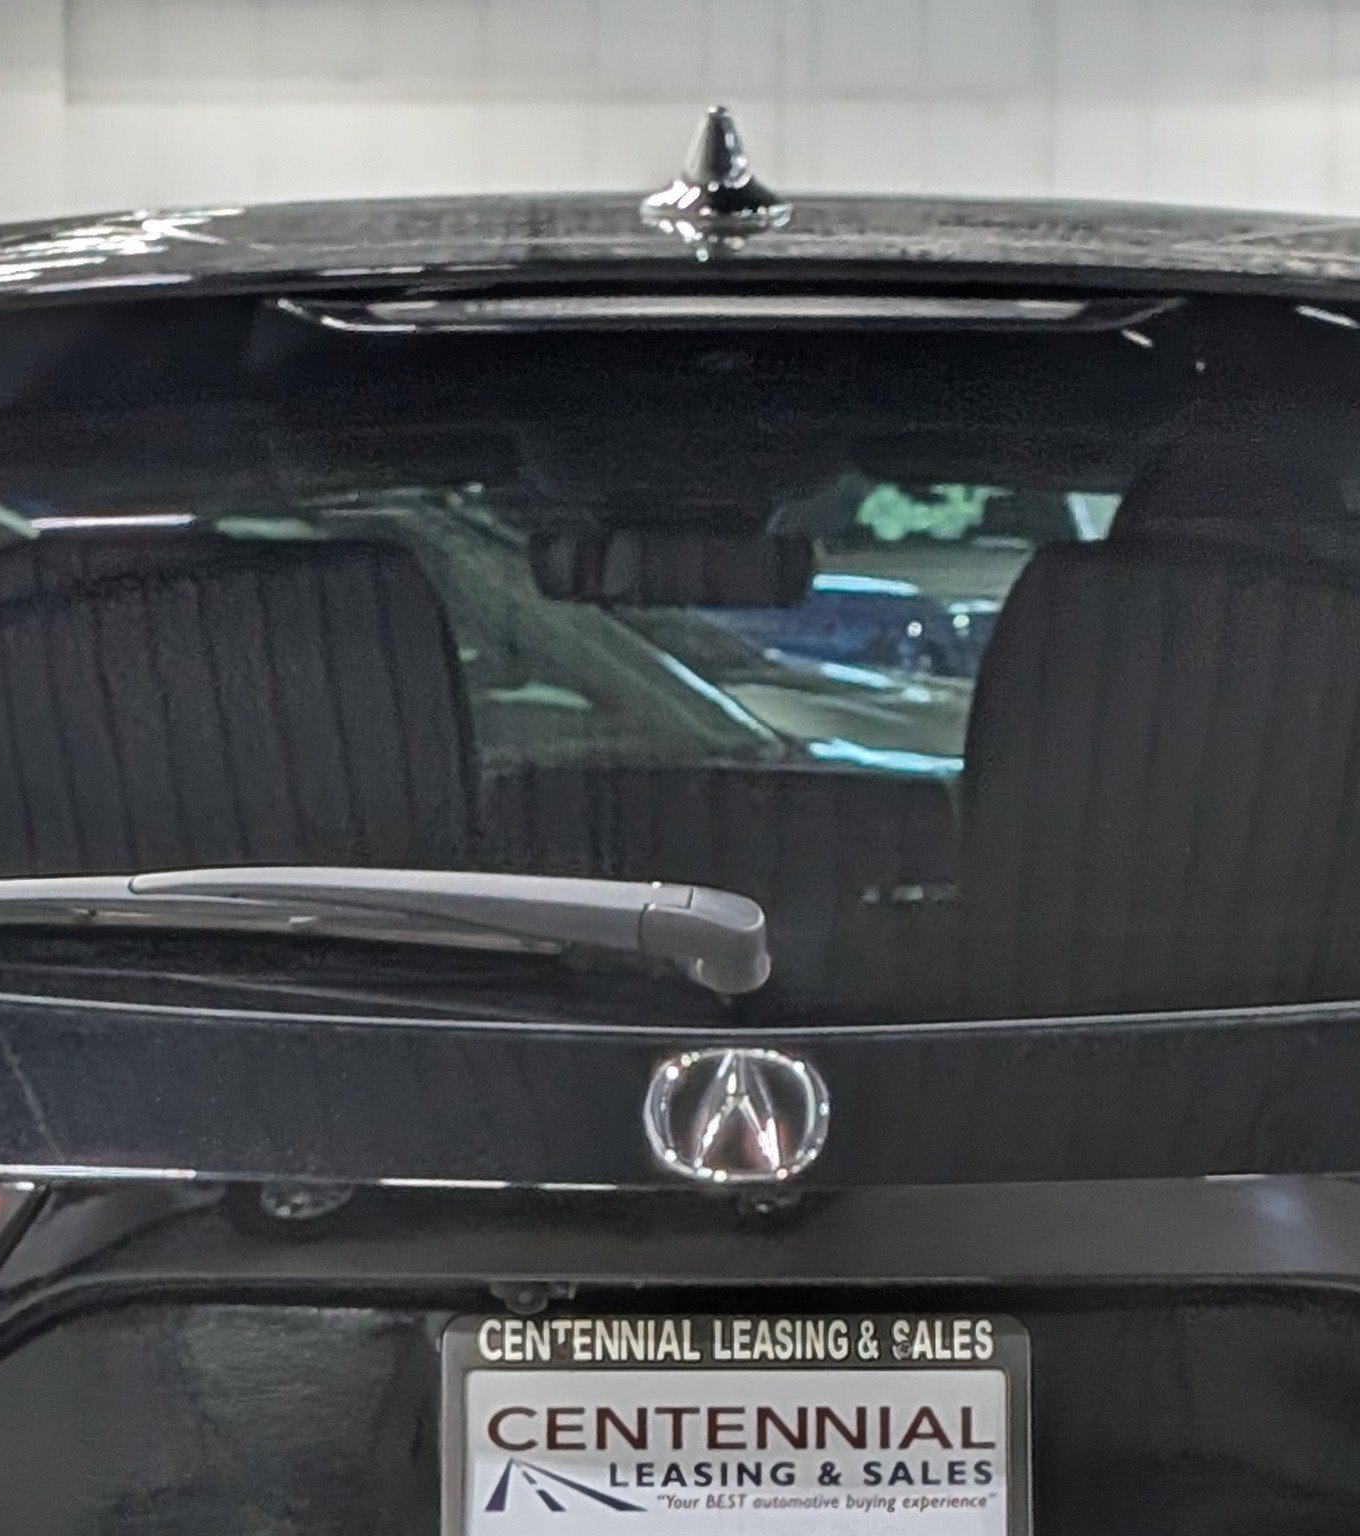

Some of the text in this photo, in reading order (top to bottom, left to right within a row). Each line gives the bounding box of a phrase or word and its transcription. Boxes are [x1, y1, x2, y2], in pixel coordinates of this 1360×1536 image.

[479, 1319, 993, 1361] CENTENNIAL LEASING & SALES
[487, 1406, 996, 1451] CENTENNIAL
[609, 1460, 993, 1488] LEASING & SALES
[705, 1494, 748, 1509] BEST
[752, 1494, 840, 1510] automotive
[845, 1494, 896, 1513] buying
